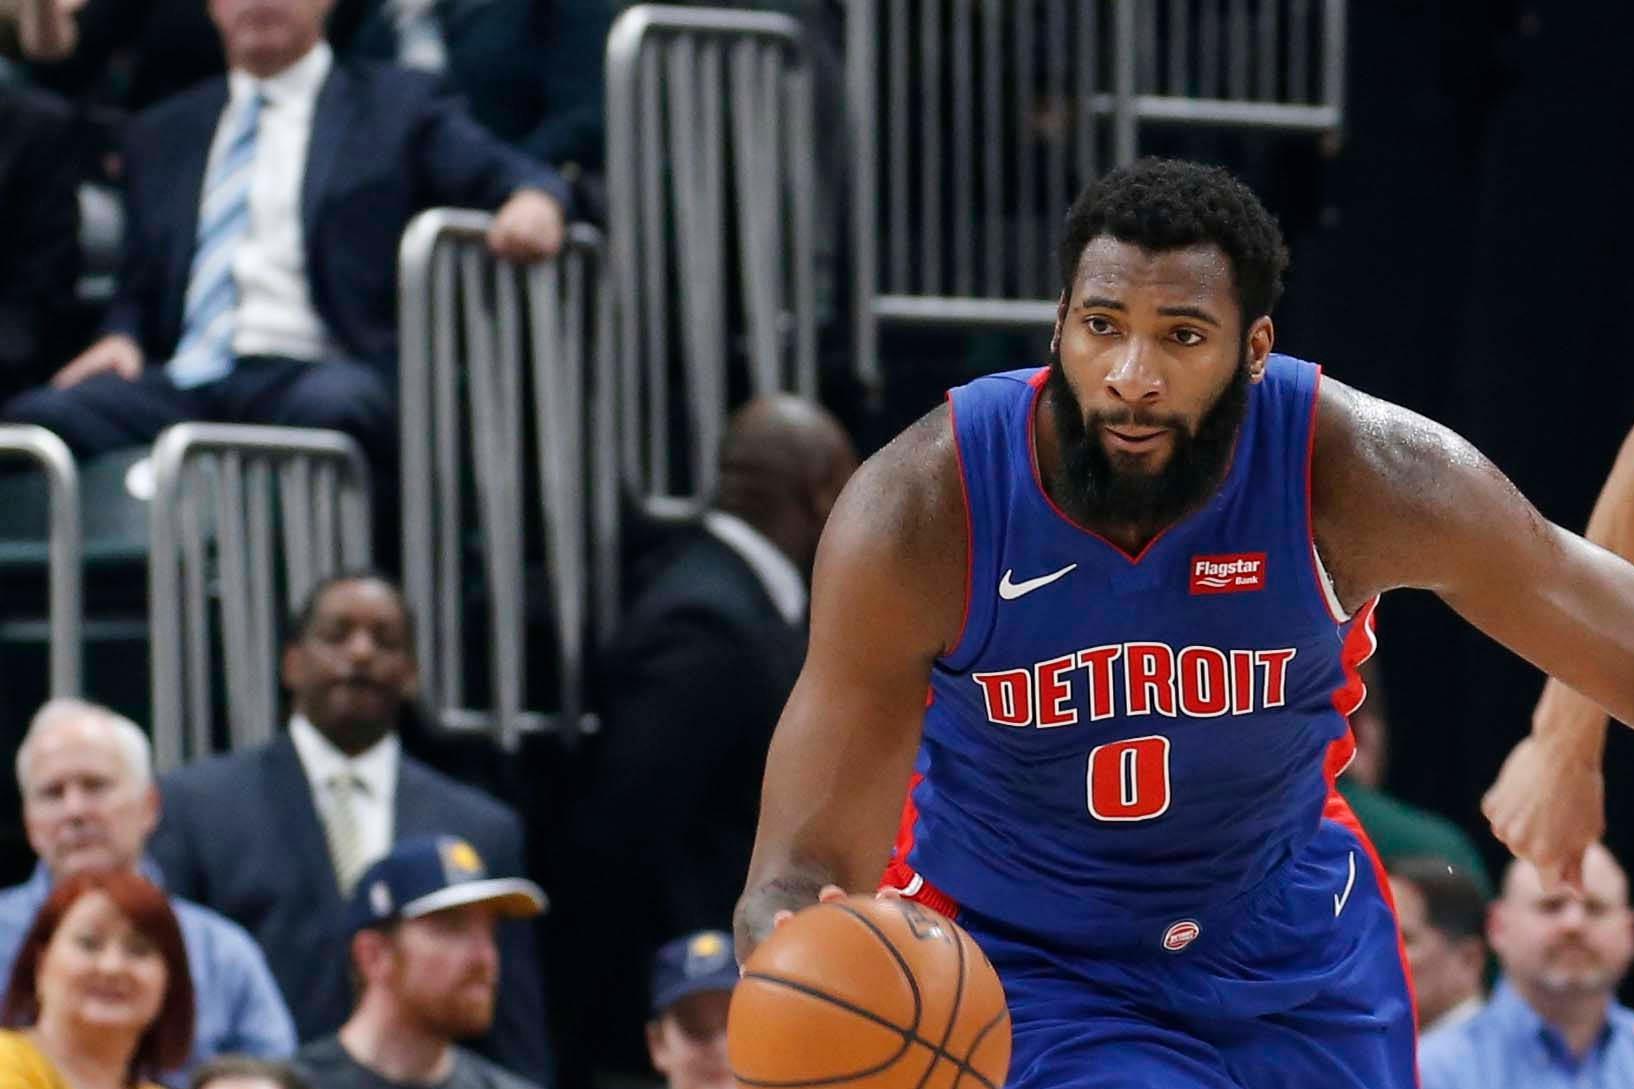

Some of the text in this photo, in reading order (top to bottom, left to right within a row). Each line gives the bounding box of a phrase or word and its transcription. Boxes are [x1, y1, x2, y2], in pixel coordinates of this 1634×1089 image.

[1195, 559, 1261, 578] Flagstar
[1235, 575, 1259, 585] Bank
[972, 641, 1297, 728] DETROIT
[1087, 735, 1171, 821] 0
